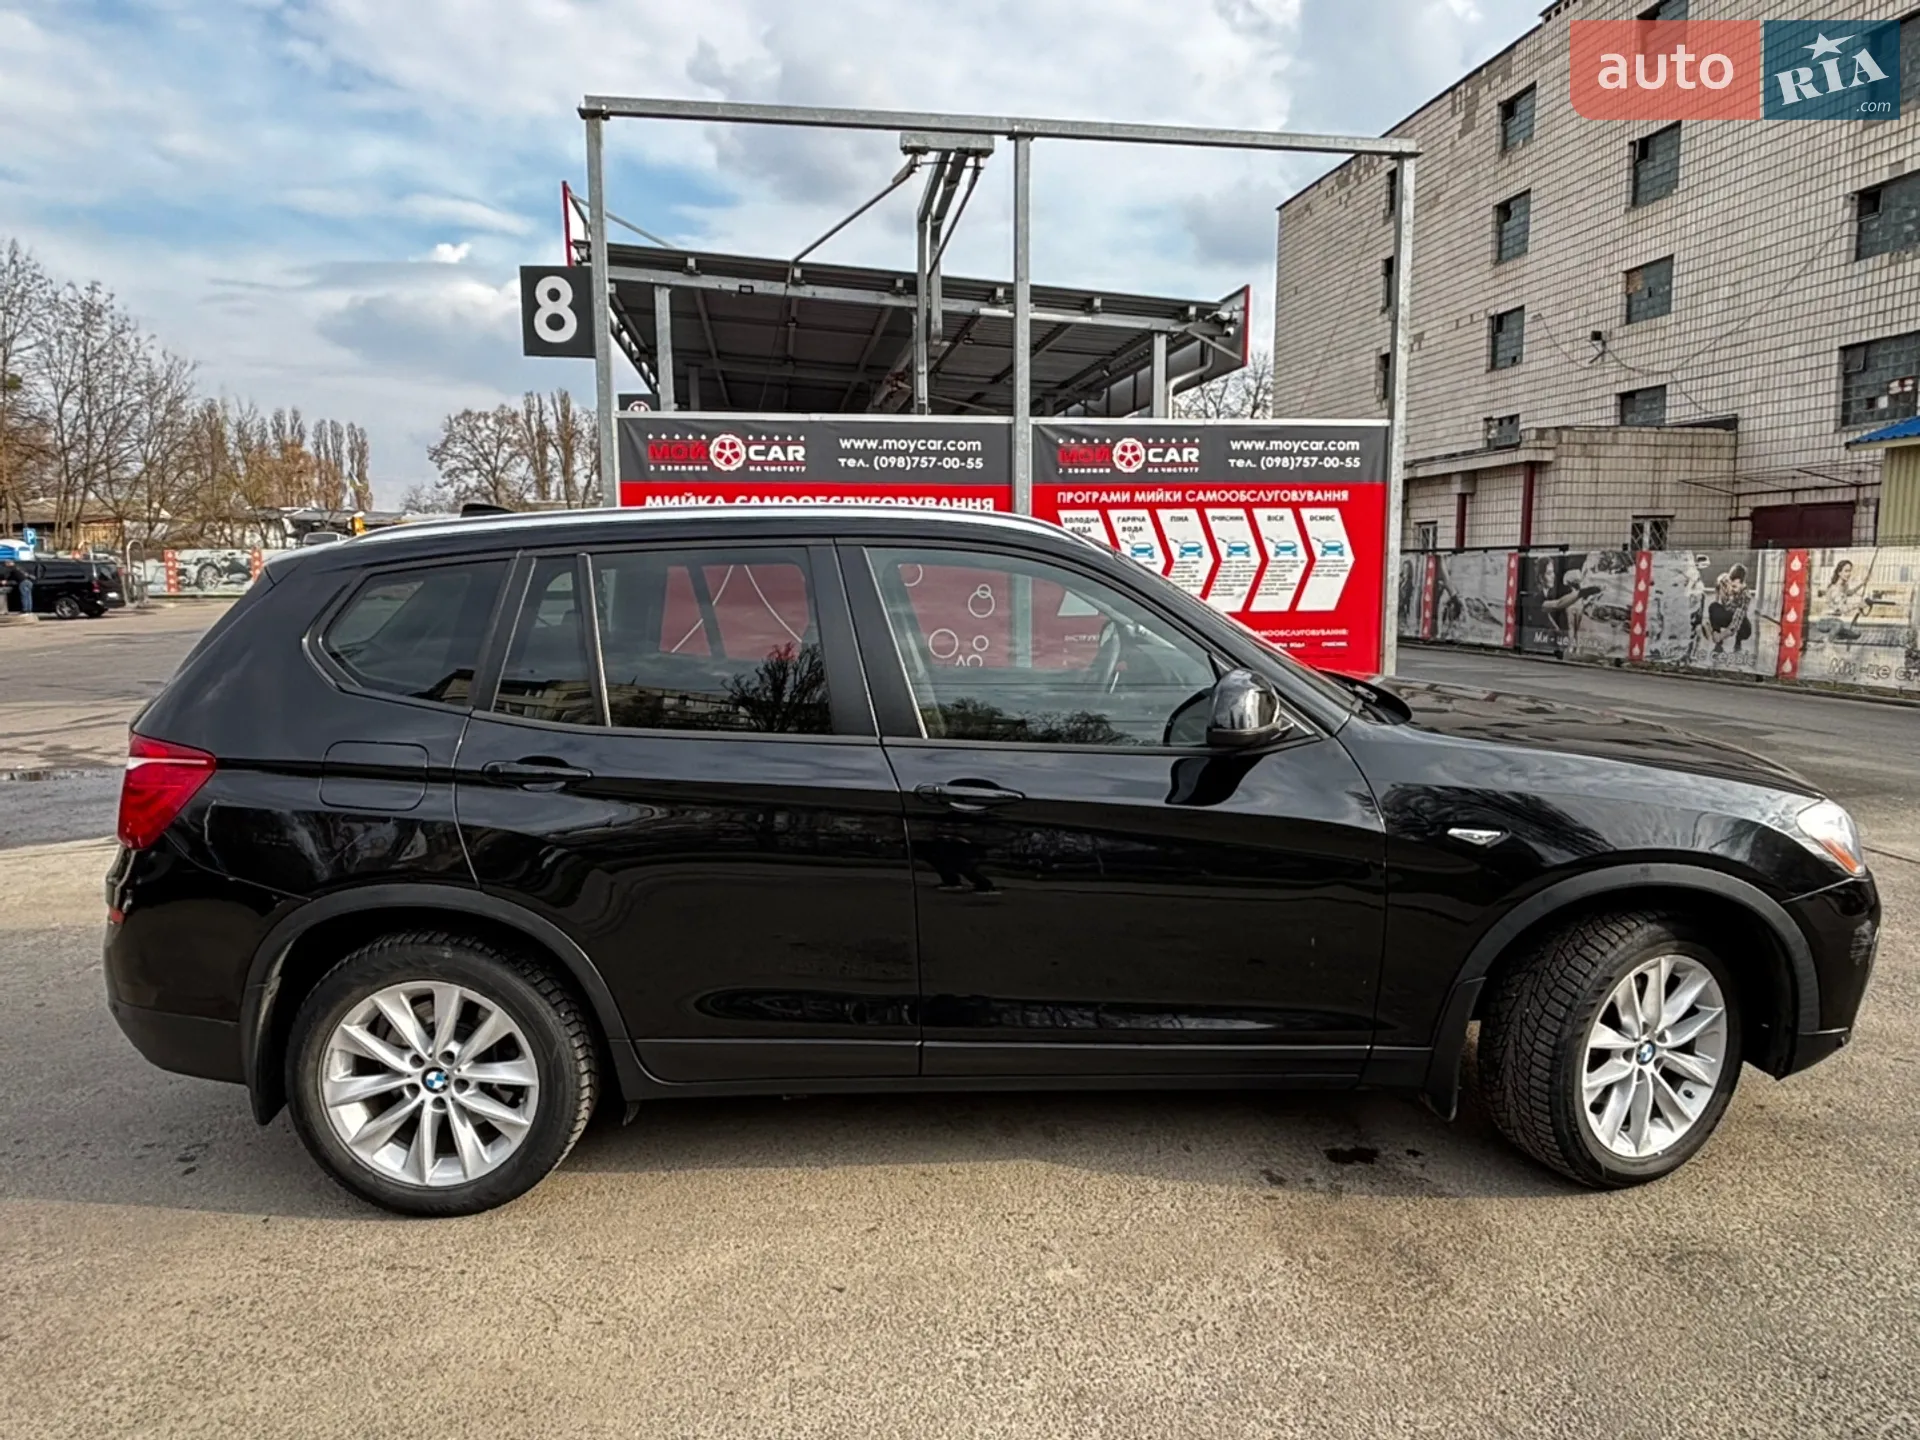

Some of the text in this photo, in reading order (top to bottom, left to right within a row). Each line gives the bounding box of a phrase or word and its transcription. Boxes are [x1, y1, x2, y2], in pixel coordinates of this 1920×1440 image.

[534, 275, 577, 343] 8
[748, 445, 806, 461] CAR
[839, 438, 982, 453] www.moycar.com
[1230, 440, 1360, 453] www.moycar.com
[1147, 447, 1200, 463] CAR
[838, 456, 984, 470] тел. (098)757-00-55
[1228, 456, 1361, 470] тел. (098)757-00-55
[645, 492, 995, 511] МИЙКА САМООБСЛУГОВУВАННЯ
[1057, 488, 1349, 503] ПРОГРАМИ МИЙКИ САМООБСЛУГОВУВАННЯ
[27, 530, 35, 544] P
[1534, 631, 1549, 644] Ми
